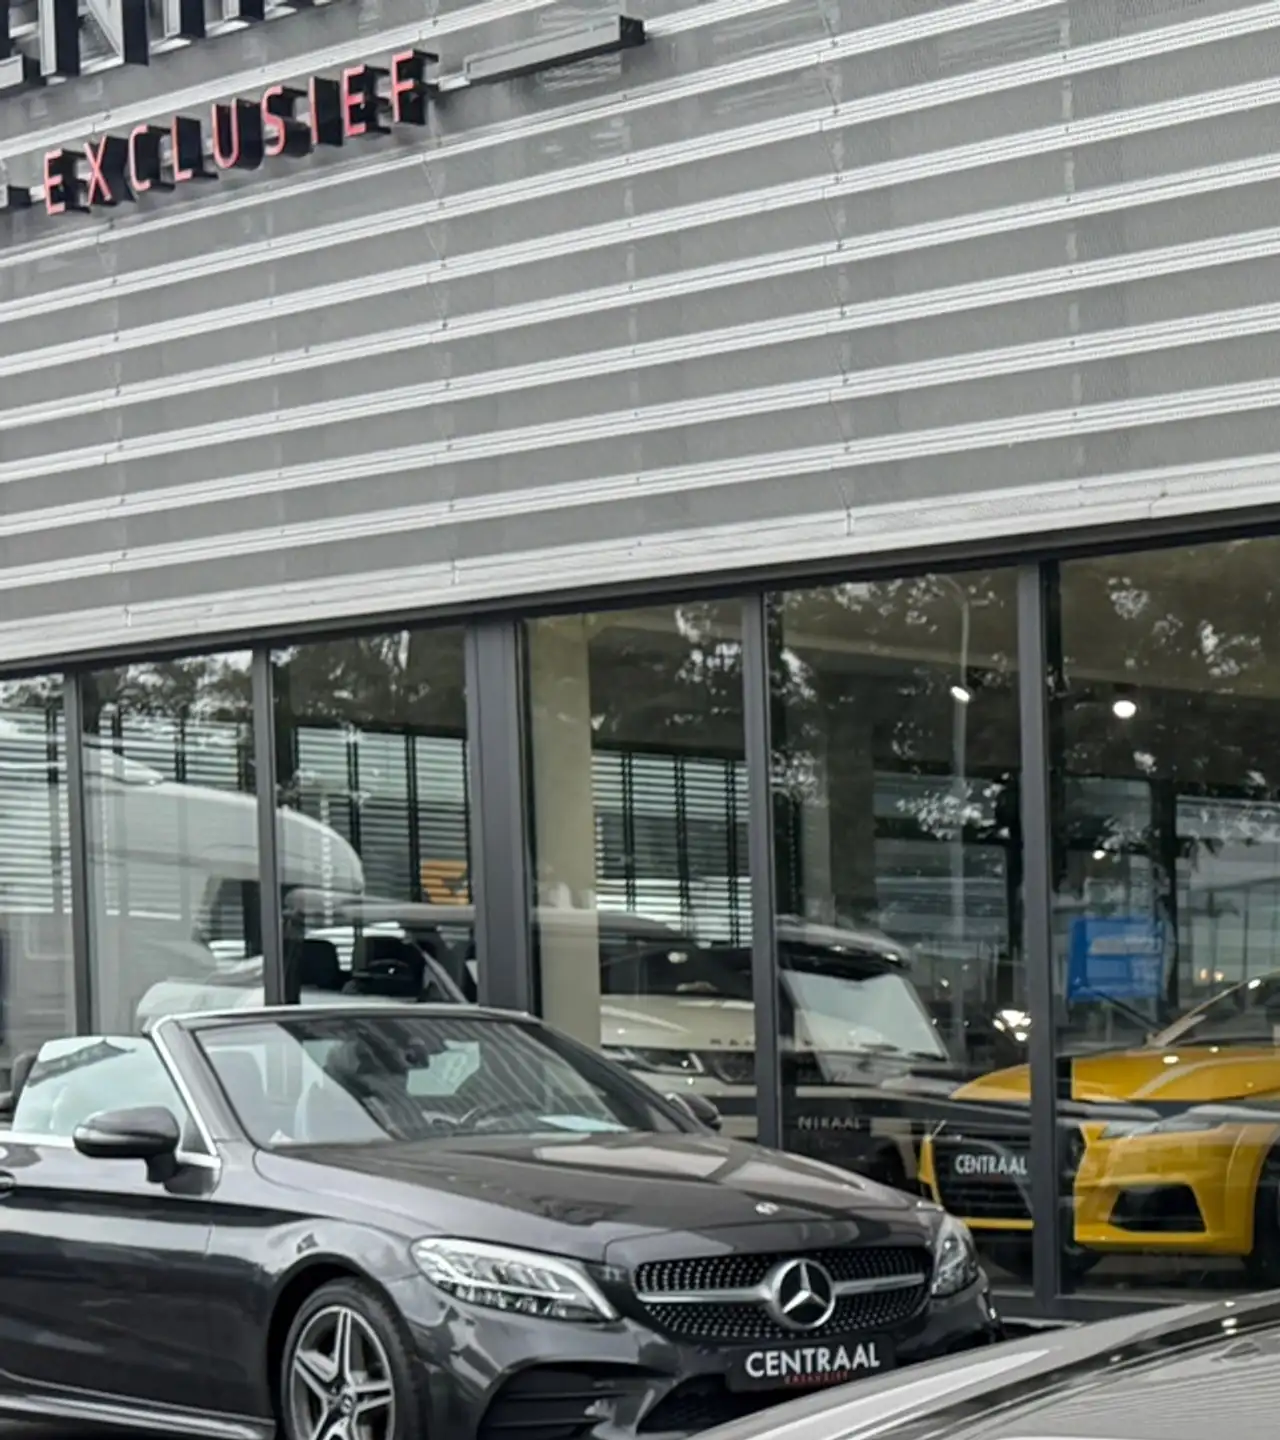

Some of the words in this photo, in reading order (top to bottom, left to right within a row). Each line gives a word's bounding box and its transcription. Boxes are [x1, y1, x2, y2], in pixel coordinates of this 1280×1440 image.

[43, 49, 415, 215] EXCLUSIEF
[955, 1155, 1027, 1175] CENTRAAL
[745, 1342, 880, 1378] CENTRAAL
